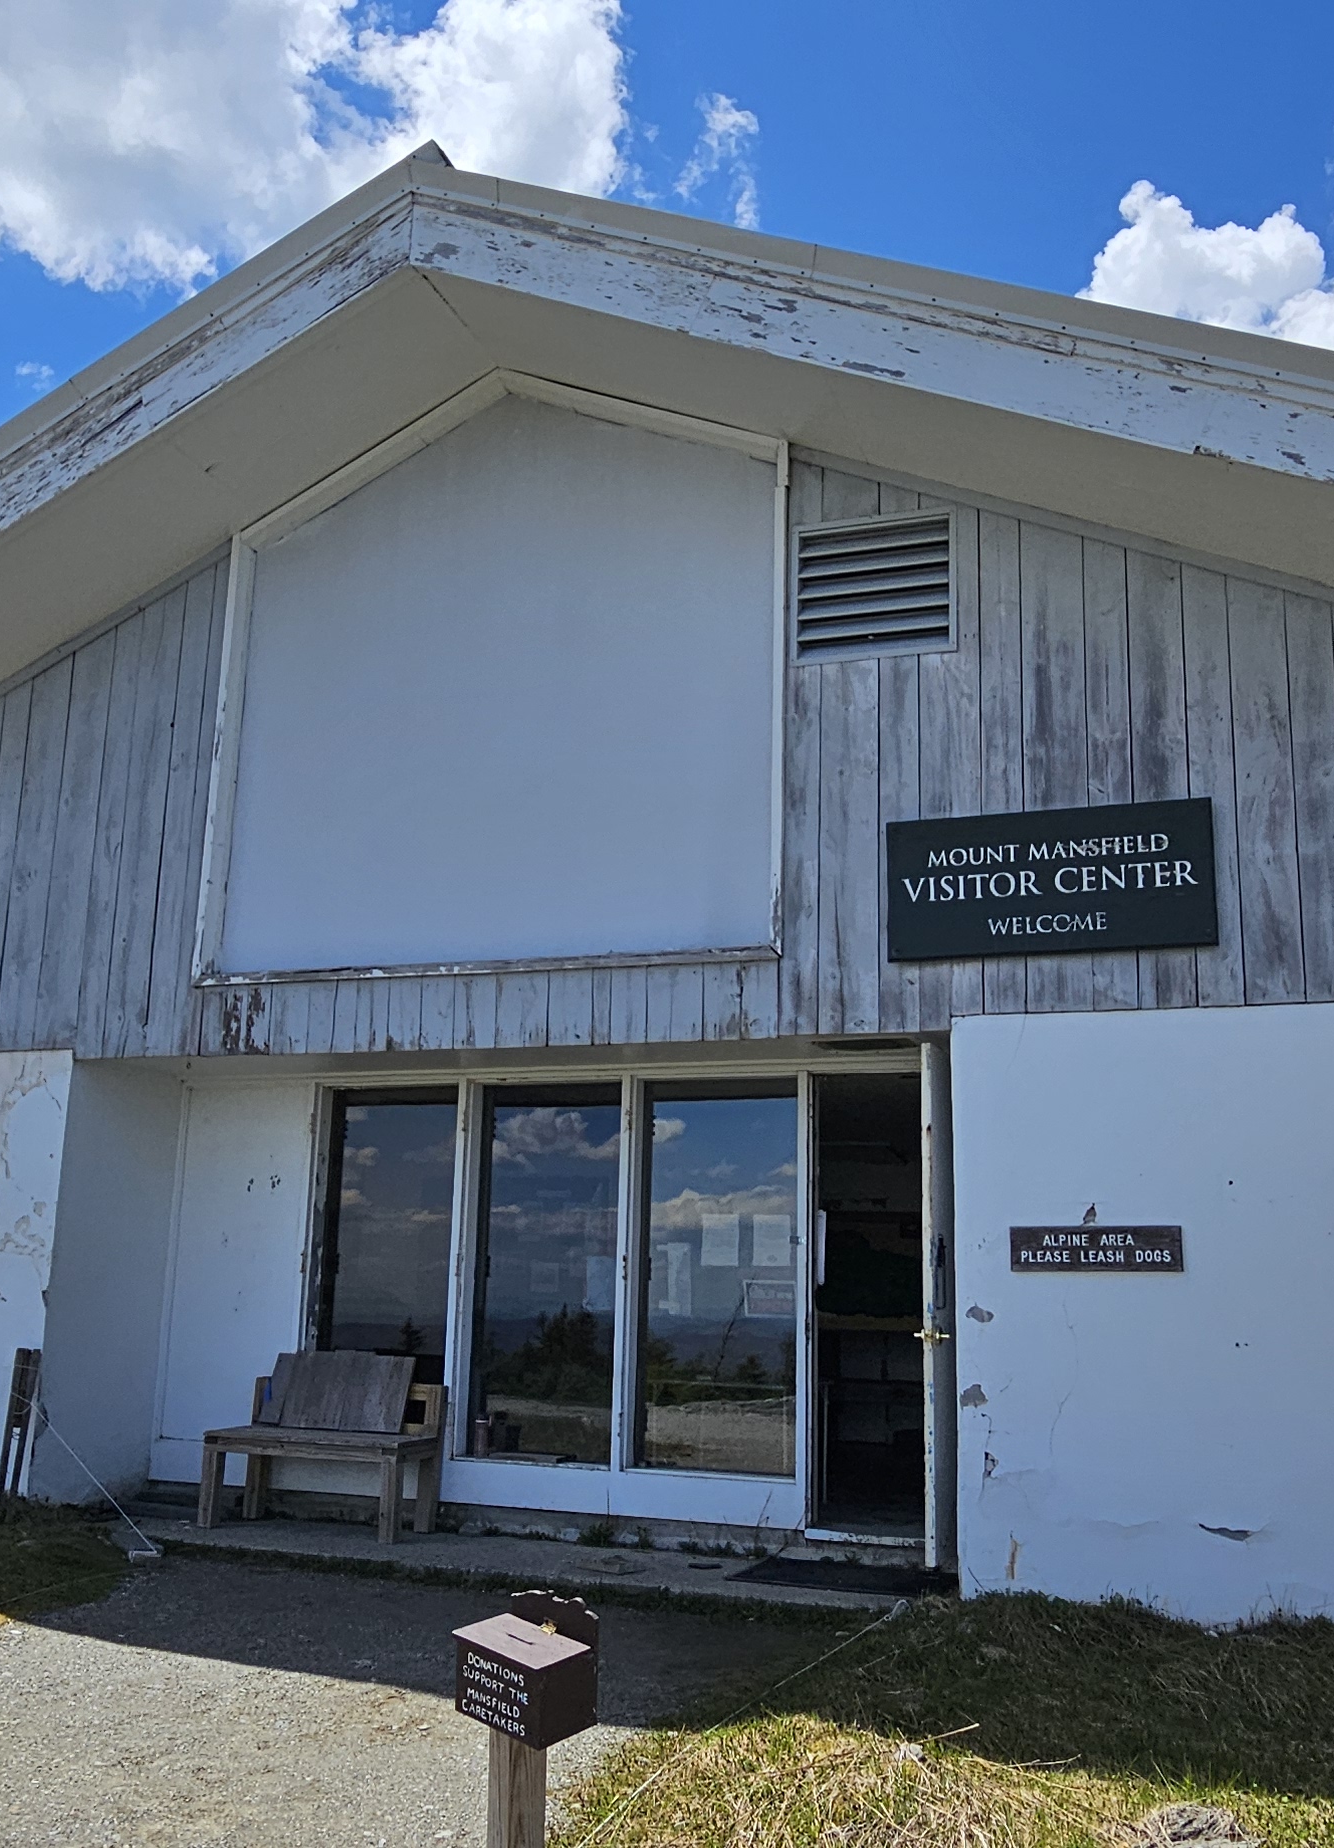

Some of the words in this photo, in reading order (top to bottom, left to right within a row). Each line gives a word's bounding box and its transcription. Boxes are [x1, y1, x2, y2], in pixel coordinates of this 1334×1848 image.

[928, 845, 1019, 867] MOUNT
[1028, 833, 1169, 861] MANSFIELD
[902, 871, 1042, 902] VISITOR
[1054, 860, 1198, 893] CENTER
[988, 912, 1107, 935] WELCOME
[1021, 1251, 1070, 1262] PLEASE
[1081, 1251, 1124, 1262] LEASH
[1136, 1250, 1171, 1262] DOGS
[1043, 1234, 1089, 1246] ALPINE
[1100, 1234, 1134, 1246] AREA
[463, 1665, 504, 1693] SUPPORT
[509, 1688, 529, 1705] THE
[468, 1652, 524, 1686] DONATIONS
[462, 1699, 525, 1736] CARETAKERS
[467, 1688, 519, 1718] MANSFIELD
